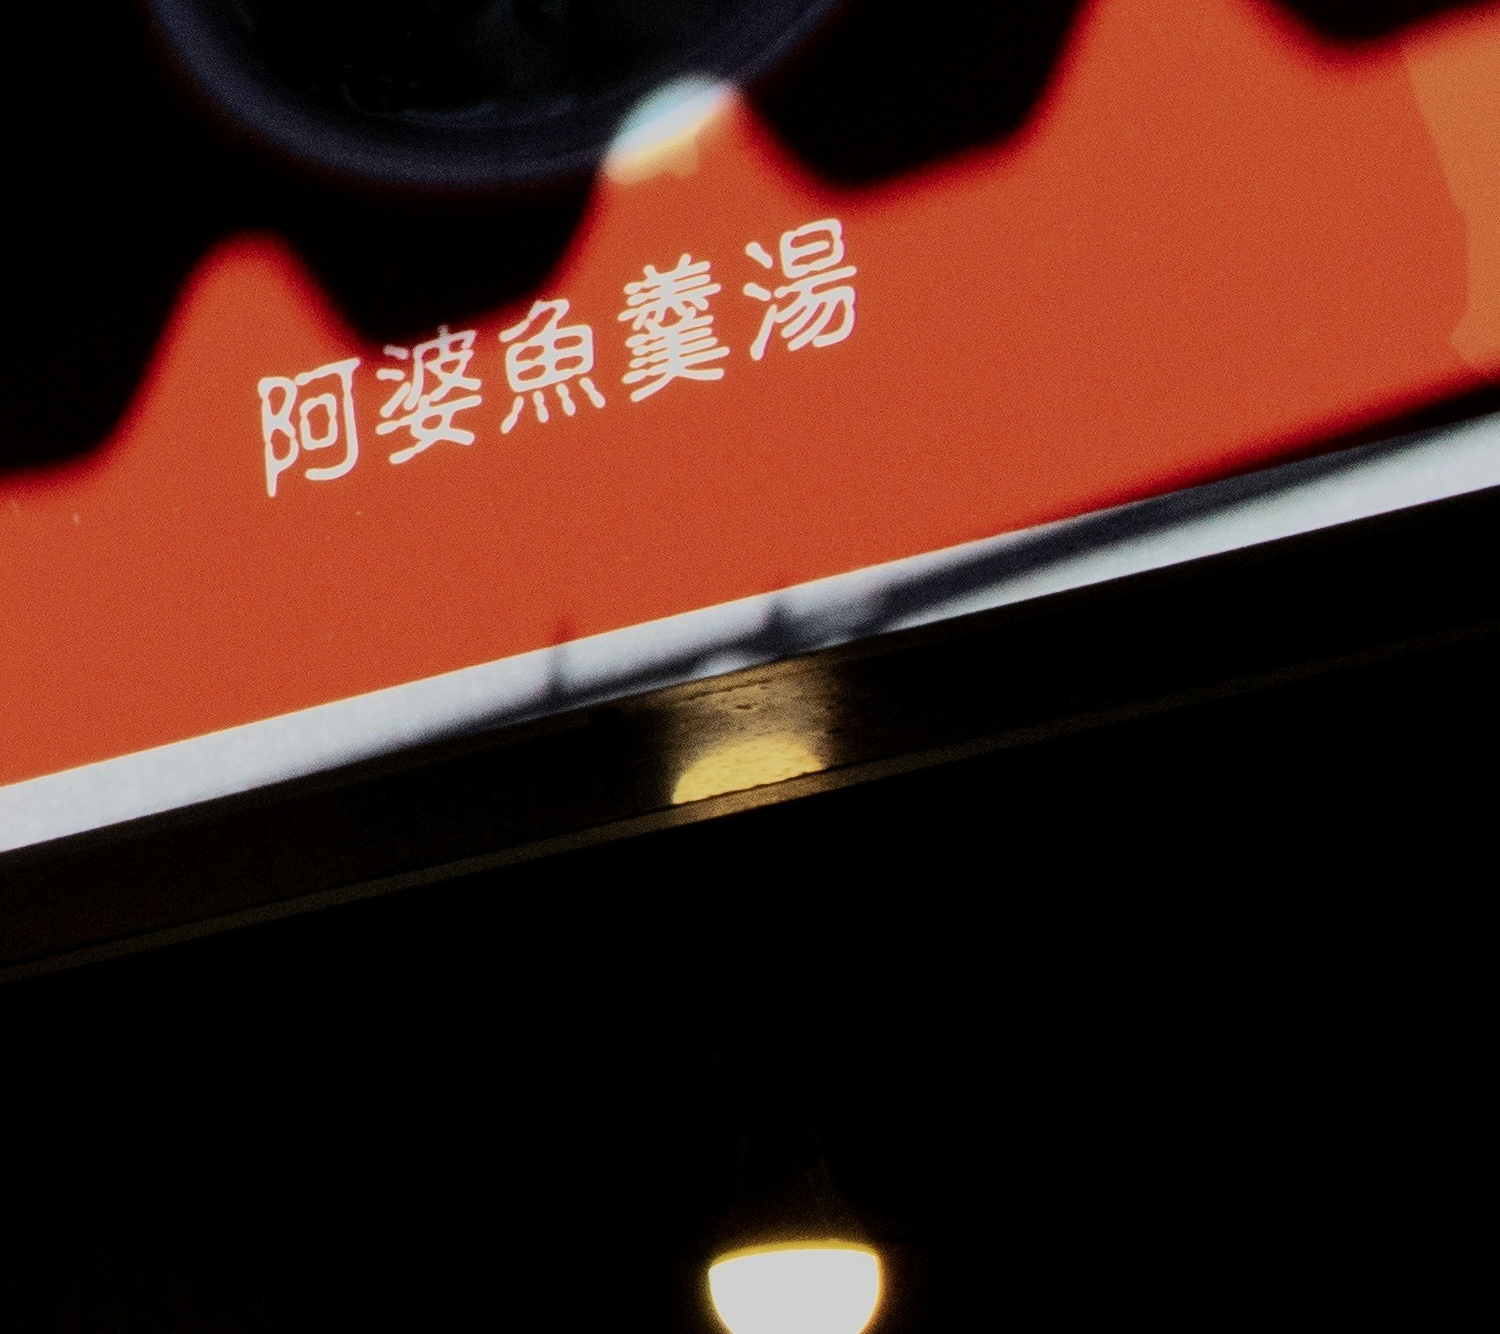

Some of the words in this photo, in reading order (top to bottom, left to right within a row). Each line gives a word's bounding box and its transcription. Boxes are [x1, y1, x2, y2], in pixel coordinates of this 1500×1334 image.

[257, 217, 858, 498] 阿婆魚羹湯
